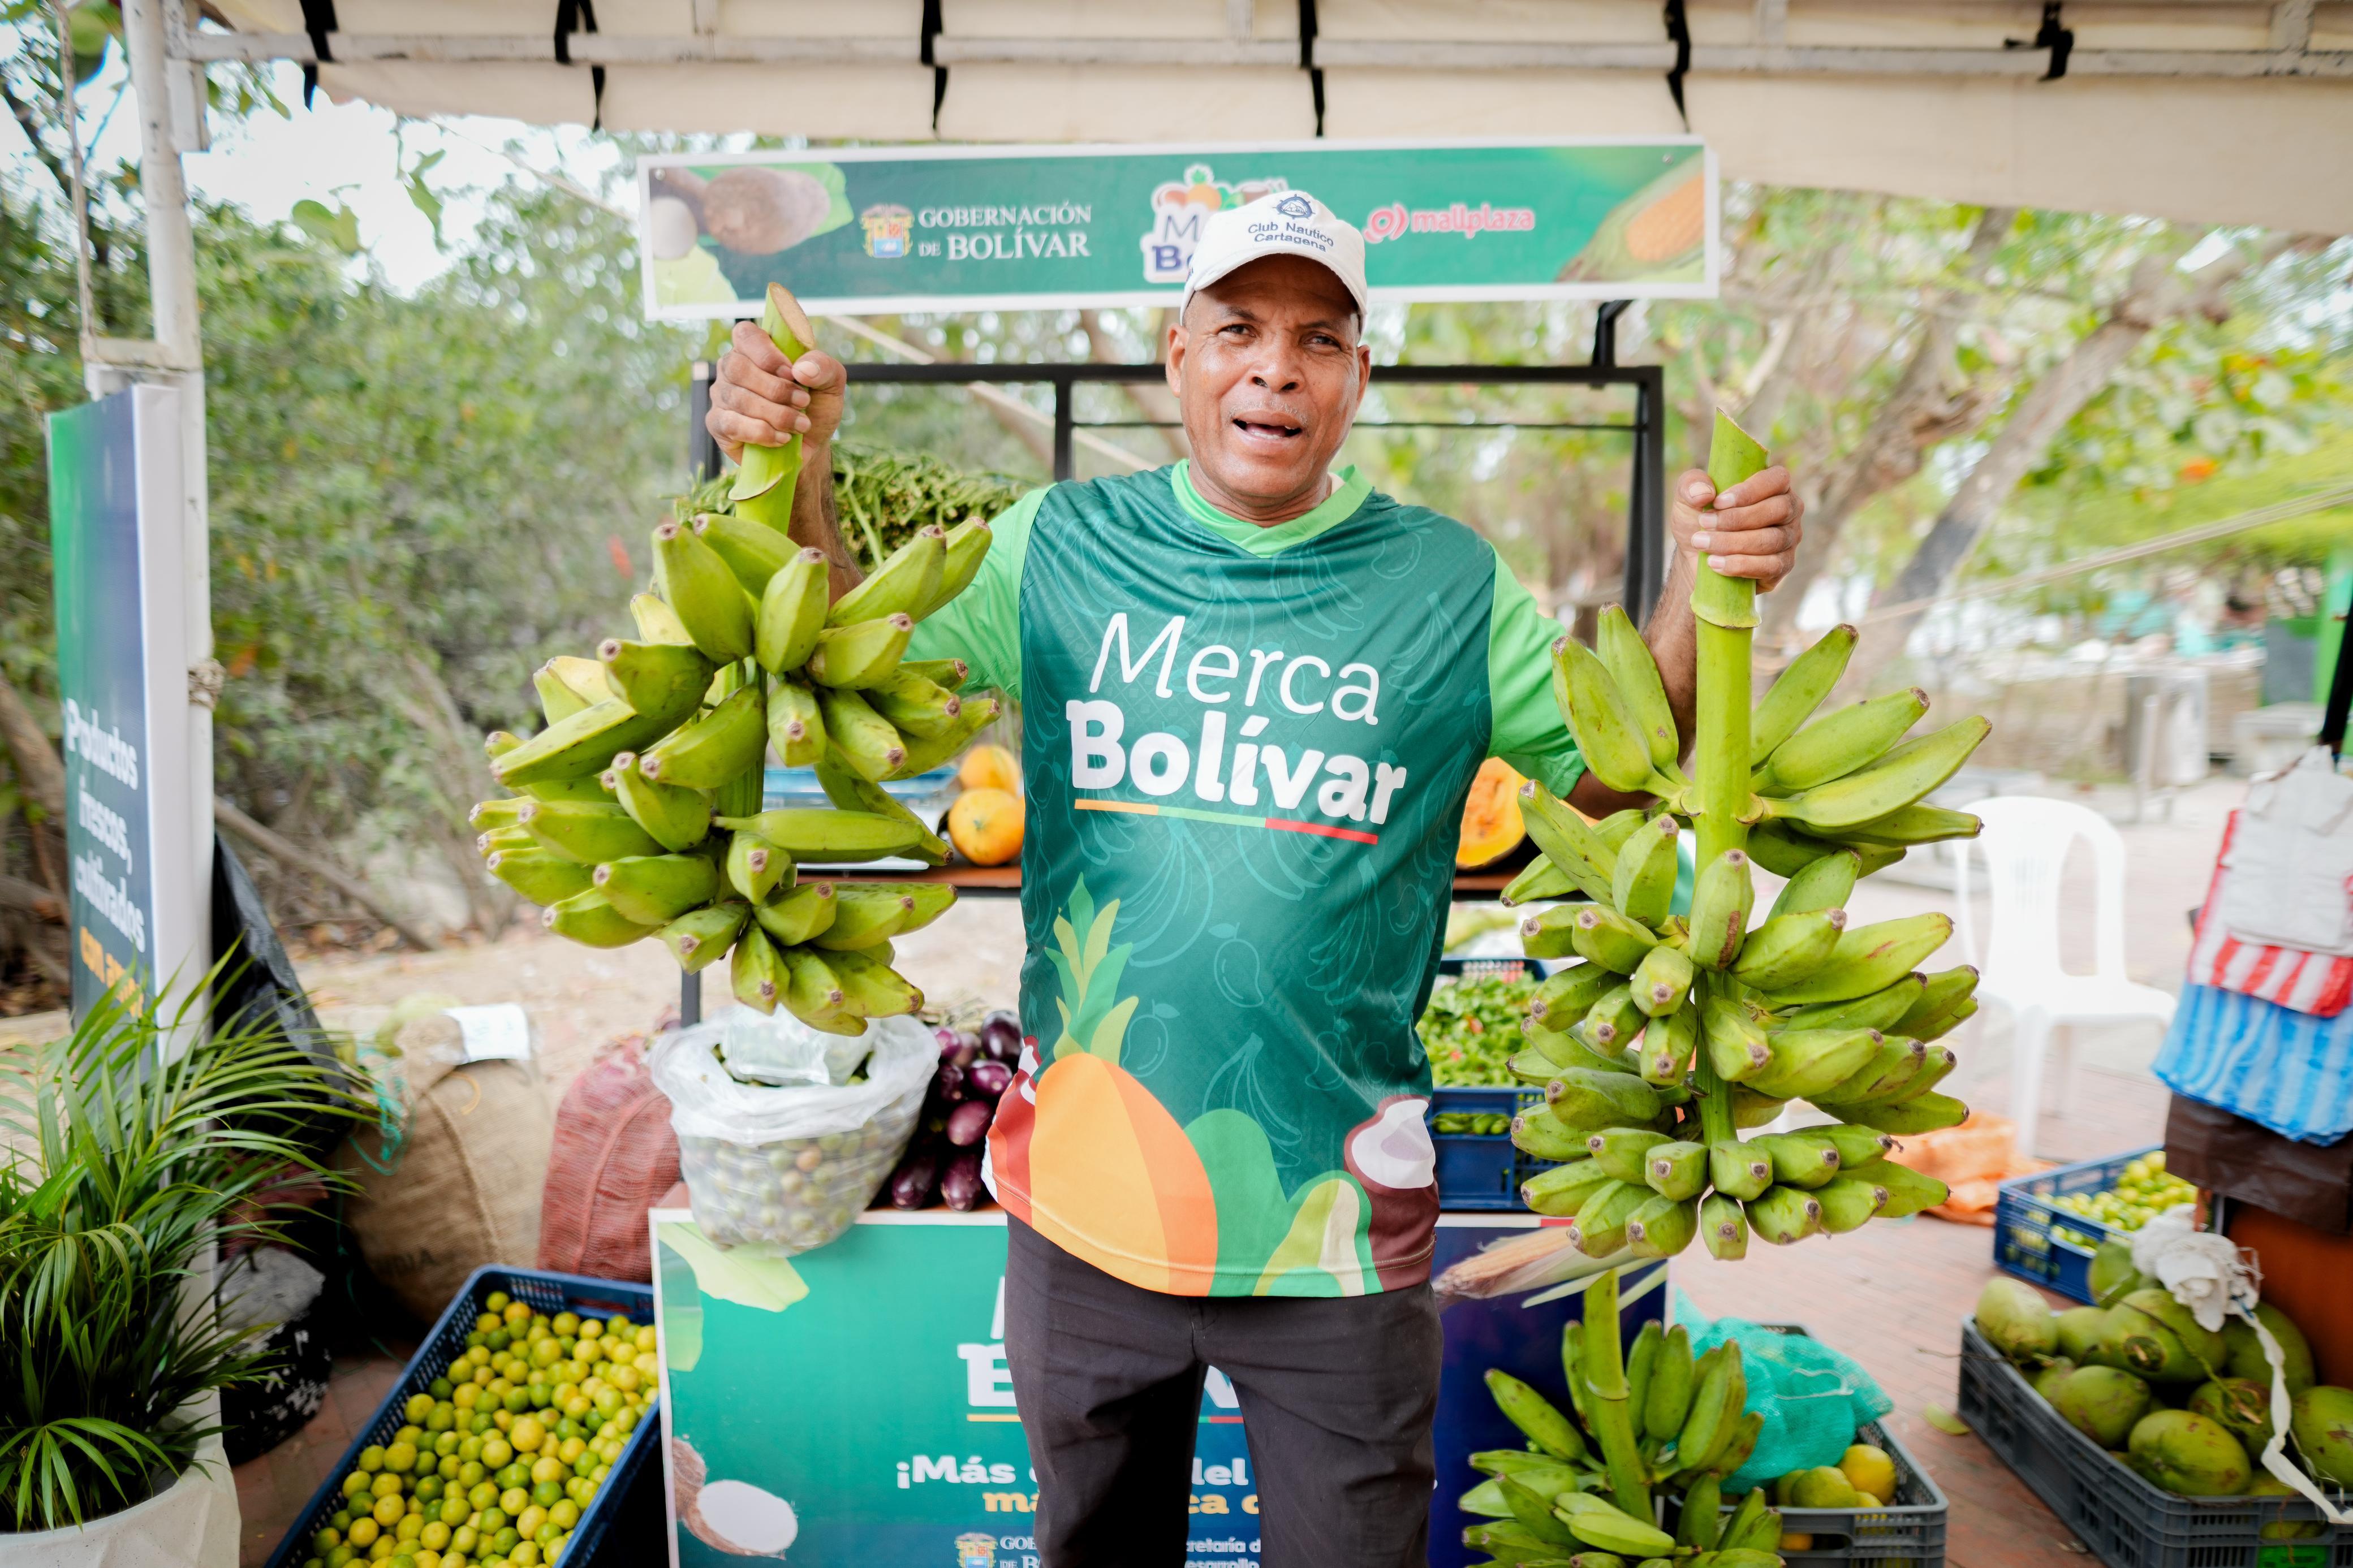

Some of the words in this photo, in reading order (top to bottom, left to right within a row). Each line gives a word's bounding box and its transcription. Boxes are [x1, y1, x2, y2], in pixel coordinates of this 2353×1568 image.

[918, 200, 1091, 228] GOBERNACIÓN
[1412, 202, 1535, 239] mallplaza
[919, 241, 941, 257] DE
[947, 226, 1092, 260] BOLÍVAR
[1248, 222, 1278, 234] Club
[1286, 222, 1334, 247] Nautico
[1254, 233, 1326, 252] Cartagena
[1089, 612, 1379, 725] Merca
[66, 697, 138, 791] Productos
[1066, 699, 1407, 824] Bolívar
[75, 849, 145, 953] cultivados
[896, 1454, 1016, 1489] ¡Más
[1187, 1536, 1246, 1553] retaría
